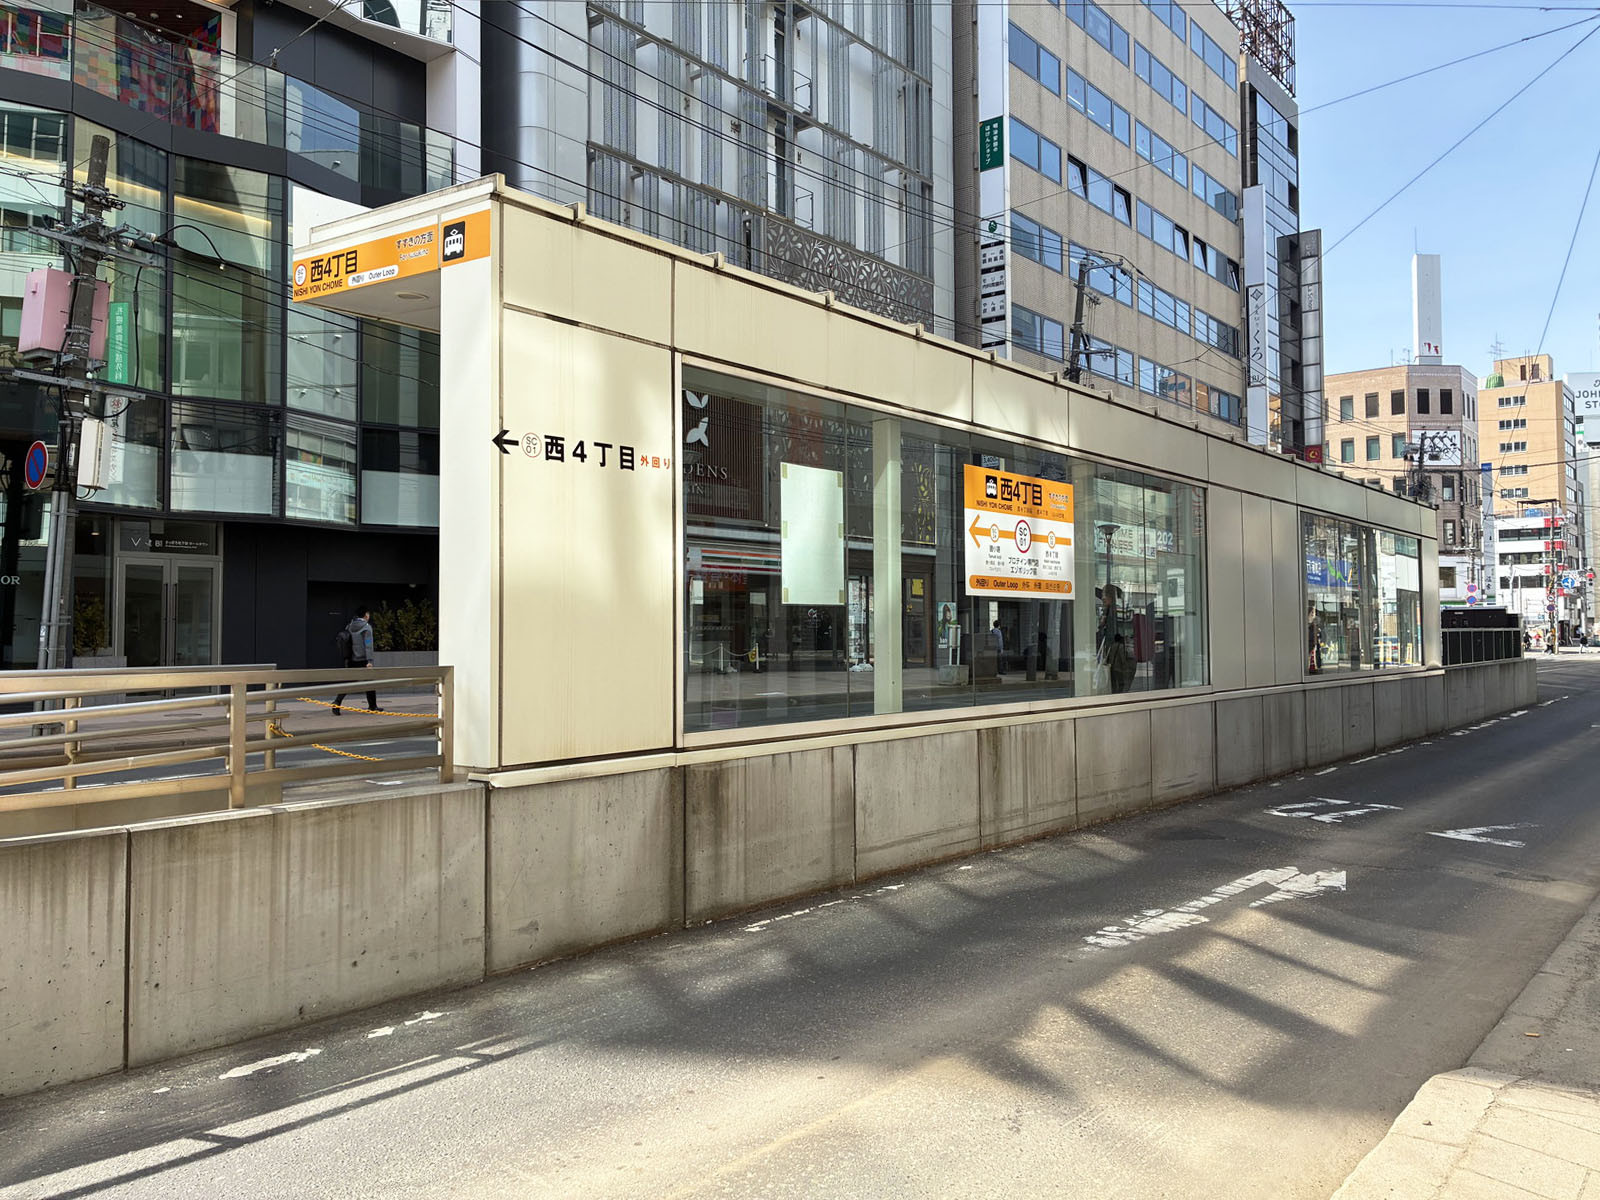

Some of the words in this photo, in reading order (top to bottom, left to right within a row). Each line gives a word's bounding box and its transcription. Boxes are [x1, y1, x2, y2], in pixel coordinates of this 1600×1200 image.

[310, 249, 358, 283] 西4丁目
[293, 286, 309, 297] NISHI
[309, 282, 321, 294] YON
[322, 278, 343, 292] CHOME
[1252, 329, 1263, 361] くろ
[1576, 390, 1600, 399] JOH
[1585, 400, 1600, 409] ST
[525, 436, 538, 446] SC
[526, 446, 537, 455] 01
[544, 435, 635, 471] 西4丁目
[640, 455, 671, 469] 外回り
[1000, 477, 1042, 506] 西4丁目
[998, 502, 1013, 511] CHOME
[1018, 526, 1028, 537] SC
[1019, 537, 1027, 547] 01
[993, 579, 1007, 588] Outer
[1006, 580, 1018, 590] Loop
